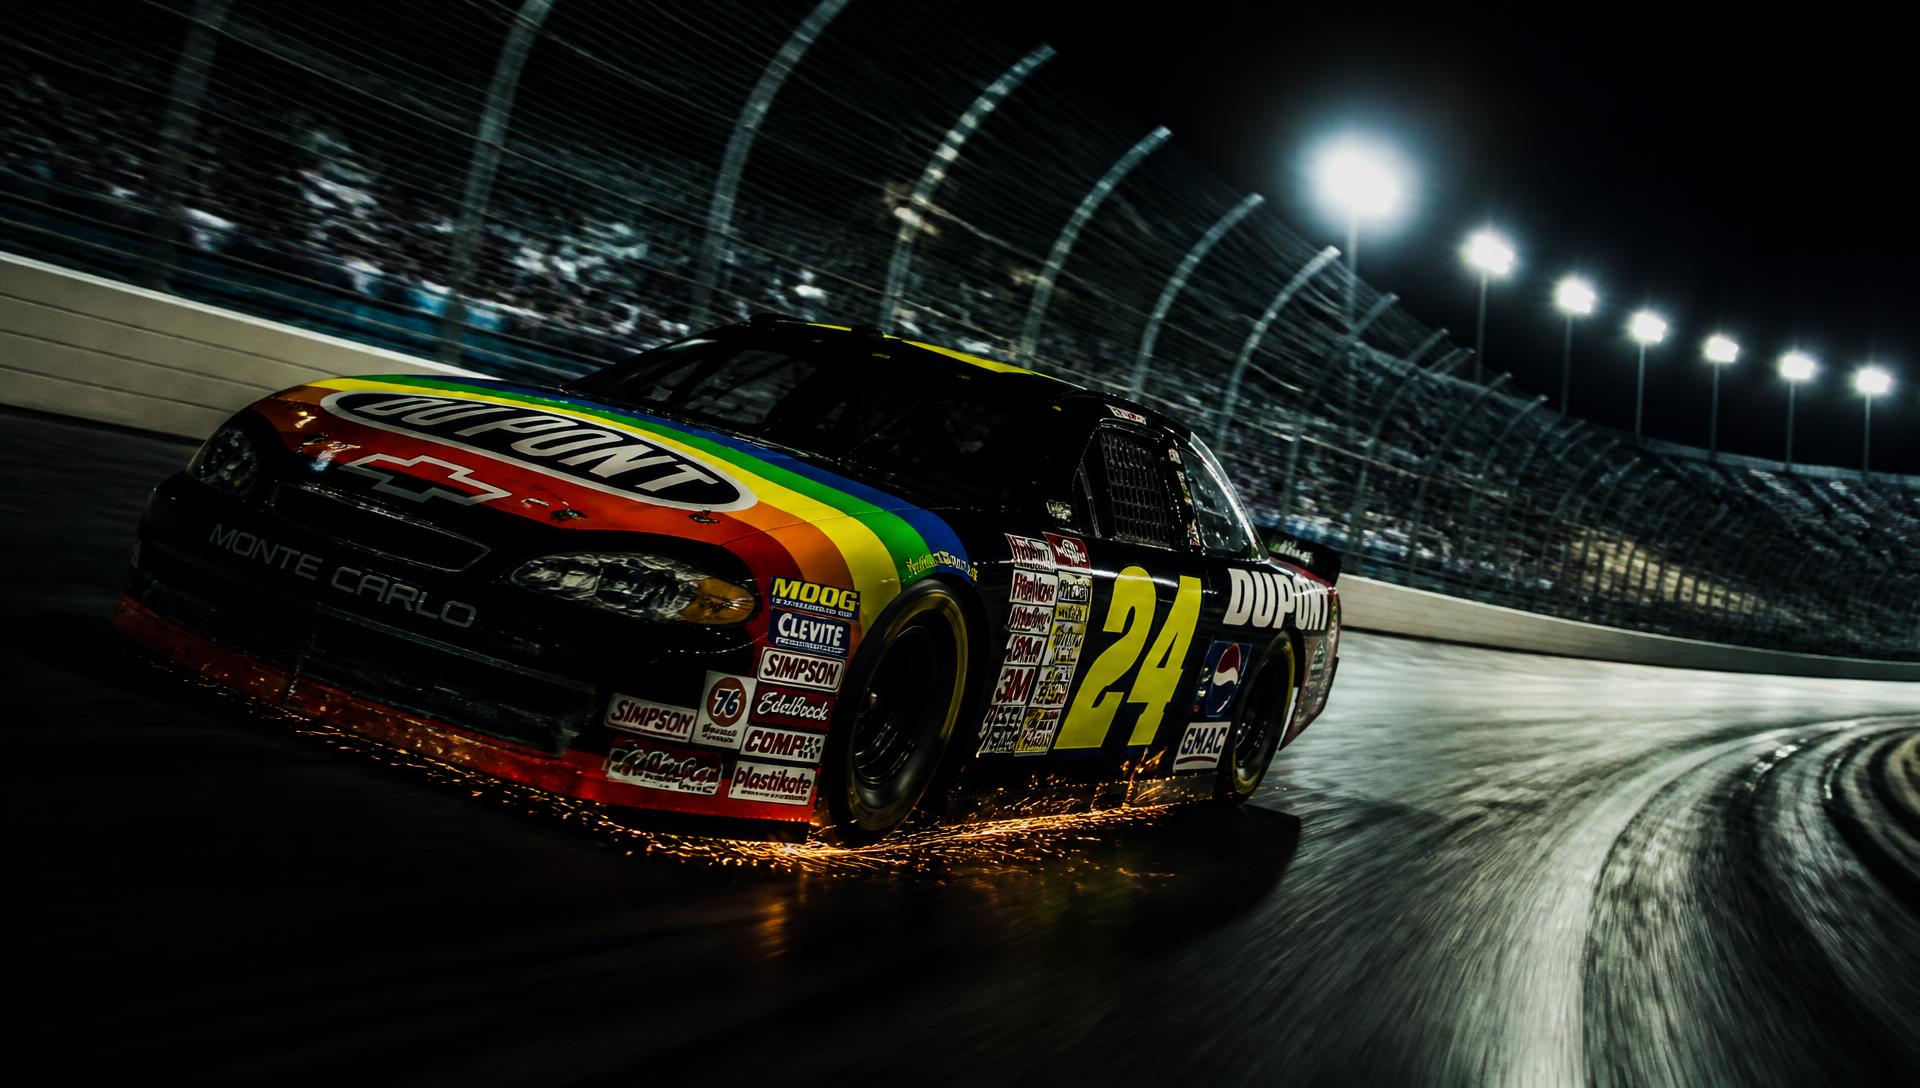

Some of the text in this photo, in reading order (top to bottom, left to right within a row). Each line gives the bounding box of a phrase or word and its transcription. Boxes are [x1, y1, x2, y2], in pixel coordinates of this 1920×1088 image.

[208, 523, 477, 629] MONTE CARLO
[772, 578, 858, 612] MOOG
[1223, 567, 1329, 631] DUPONT
[777, 612, 844, 647] CLEVITE
[764, 654, 840, 686] SIMPSON
[1054, 566, 1201, 750] 24
[713, 689, 740, 718] 76
[995, 668, 1035, 704] 3M
[611, 700, 694, 735] SIMPSON
[1182, 727, 1226, 756] GMAC
[736, 766, 811, 795] plastikote
